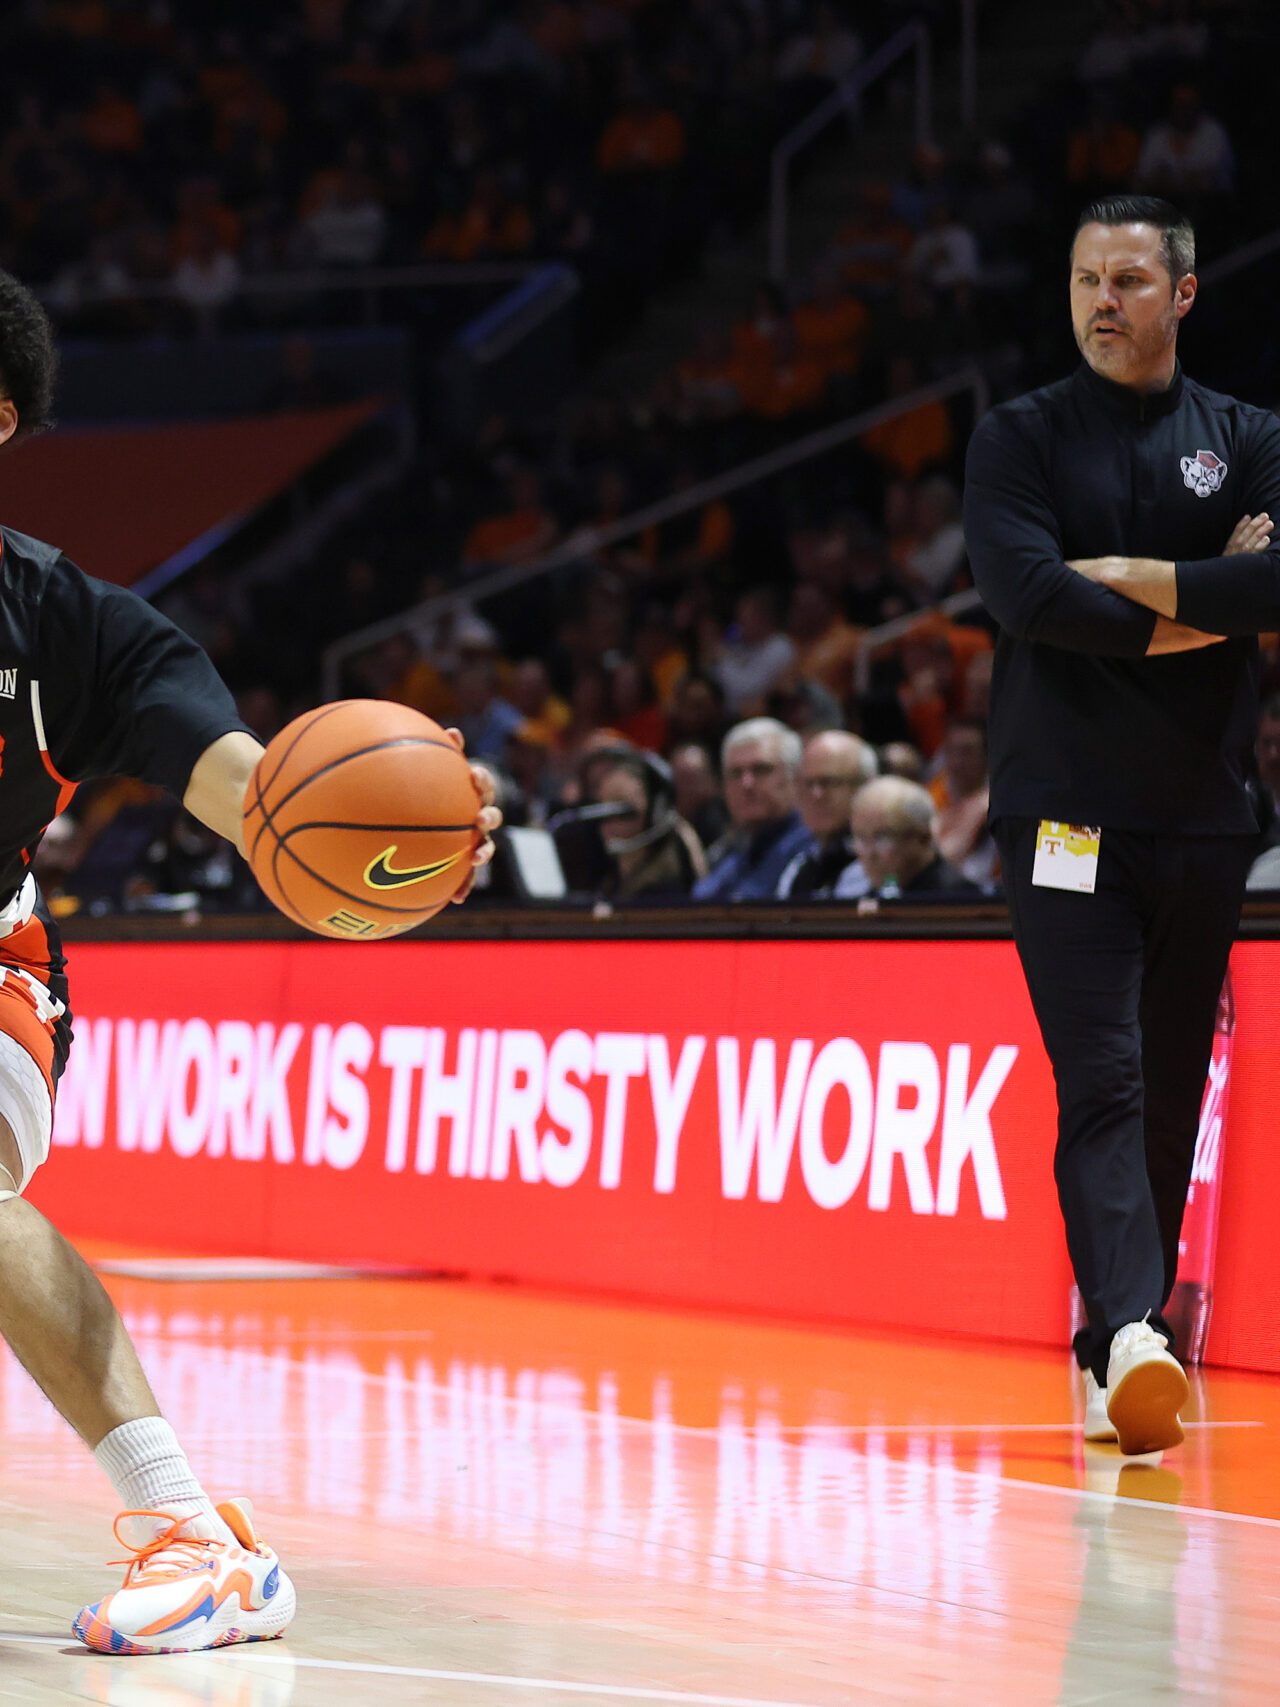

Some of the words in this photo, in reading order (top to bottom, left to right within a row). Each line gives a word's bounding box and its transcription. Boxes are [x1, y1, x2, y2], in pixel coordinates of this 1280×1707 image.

[52, 1016, 114, 1149] N
[116, 1017, 304, 1165] WORK
[303, 1021, 375, 1171] IS
[378, 1024, 708, 1195] THIRSTY
[715, 1035, 1021, 1222] WORK
